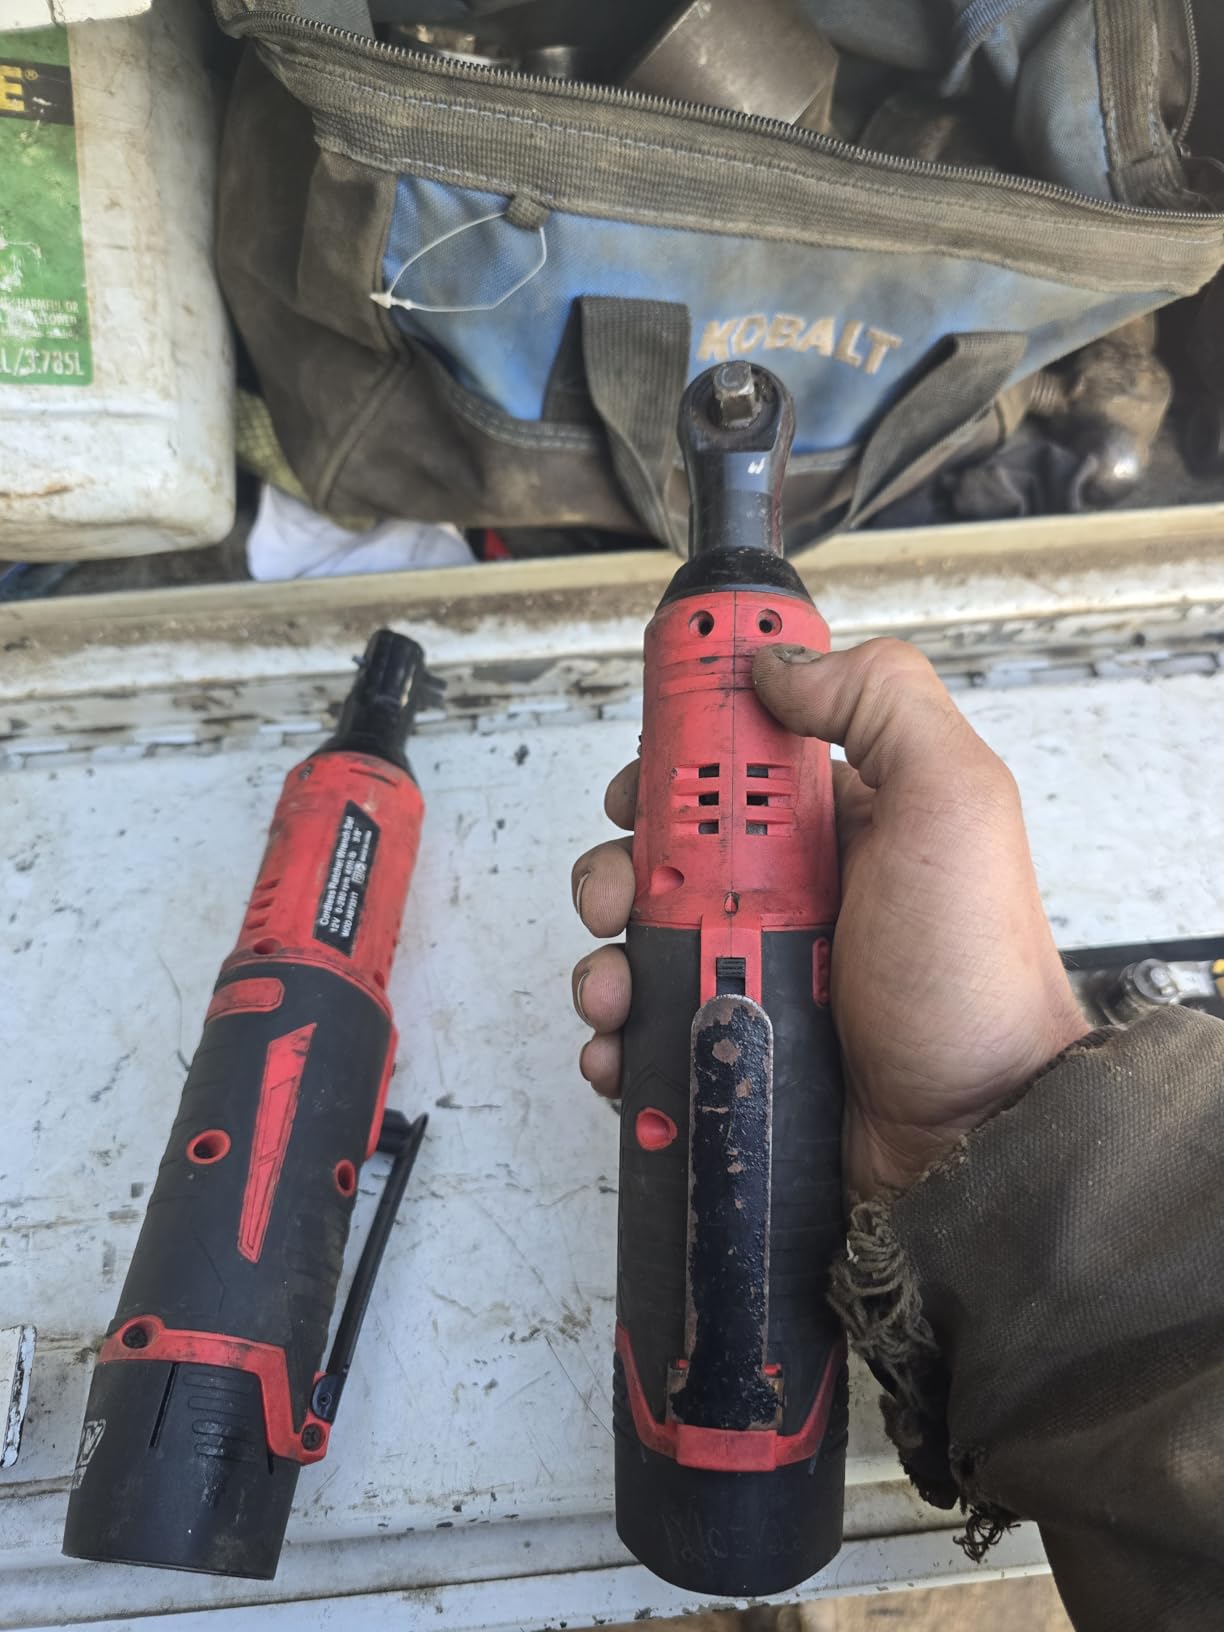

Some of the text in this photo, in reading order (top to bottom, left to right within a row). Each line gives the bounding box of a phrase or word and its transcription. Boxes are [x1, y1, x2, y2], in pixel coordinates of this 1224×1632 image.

[65, 301, 80, 313] OR
[697, 313, 903, 374] KOBALT
[319, 815, 354, 926] Cordless Ratchet Wrench Set
[329, 916, 340, 933] 12V
[341, 875, 351, 891] rpm
